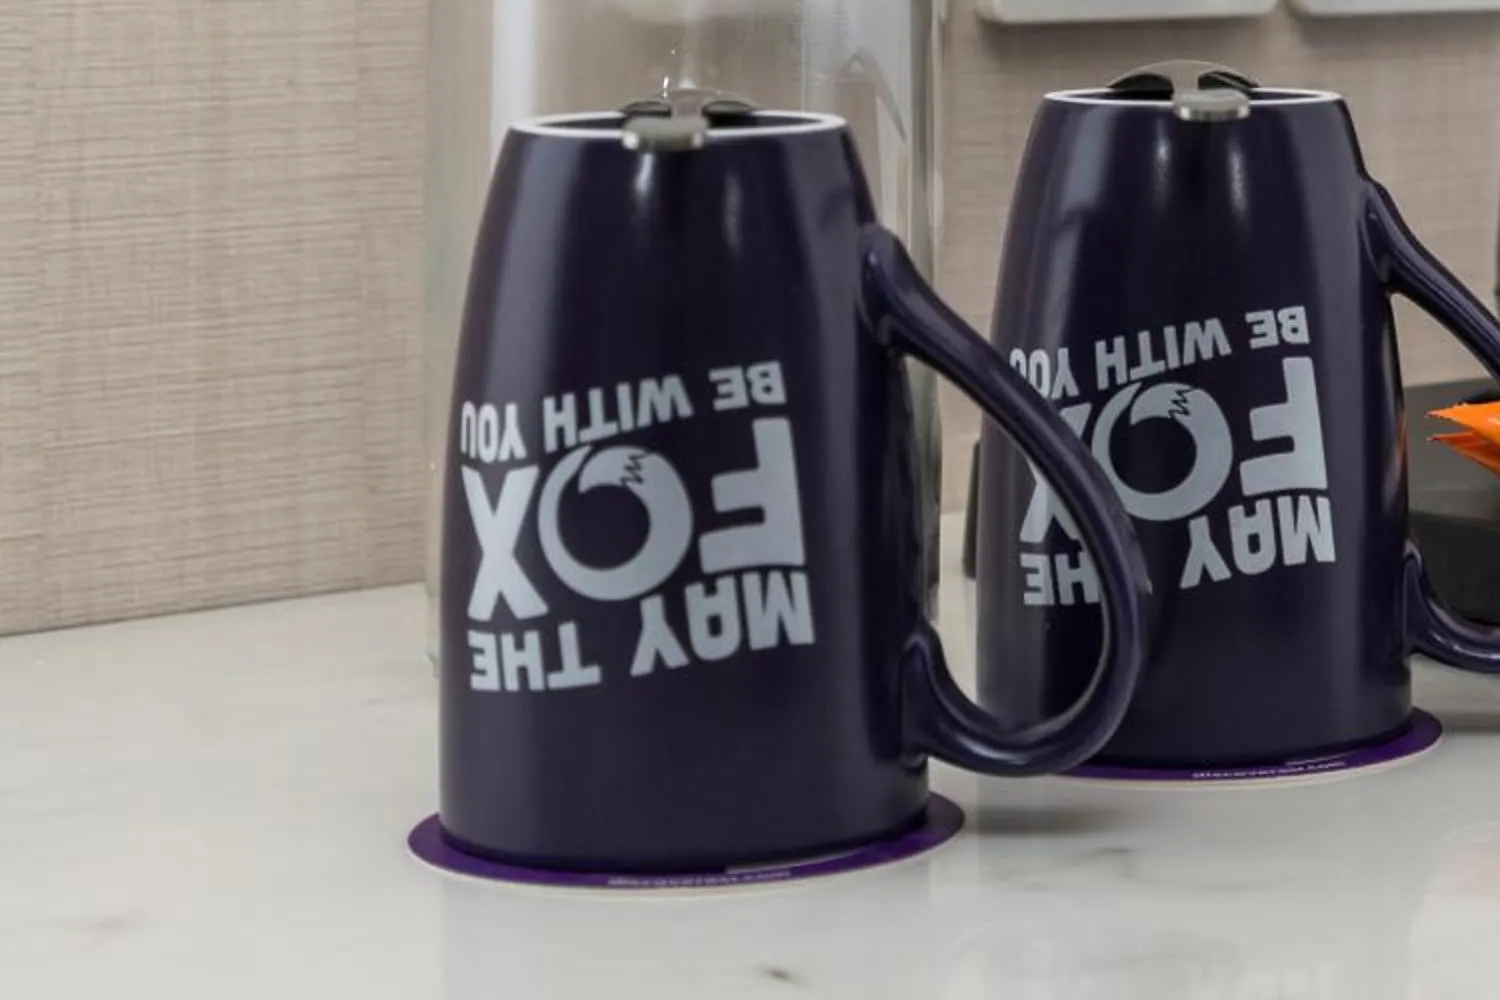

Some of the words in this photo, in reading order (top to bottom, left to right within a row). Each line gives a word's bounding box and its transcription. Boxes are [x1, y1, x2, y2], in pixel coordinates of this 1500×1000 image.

[1095, 317, 1232, 391] WITH
[1245, 305, 1310, 349] BE
[543, 374, 694, 453] WITH
[708, 360, 787, 411] BE
[460, 400, 527, 464] YOU
[460, 416, 805, 622] FOX
[1179, 494, 1336, 590] MAY
[1019, 551, 1104, 606] HE
[467, 621, 601, 691] THE
[630, 570, 815, 677] MAY
